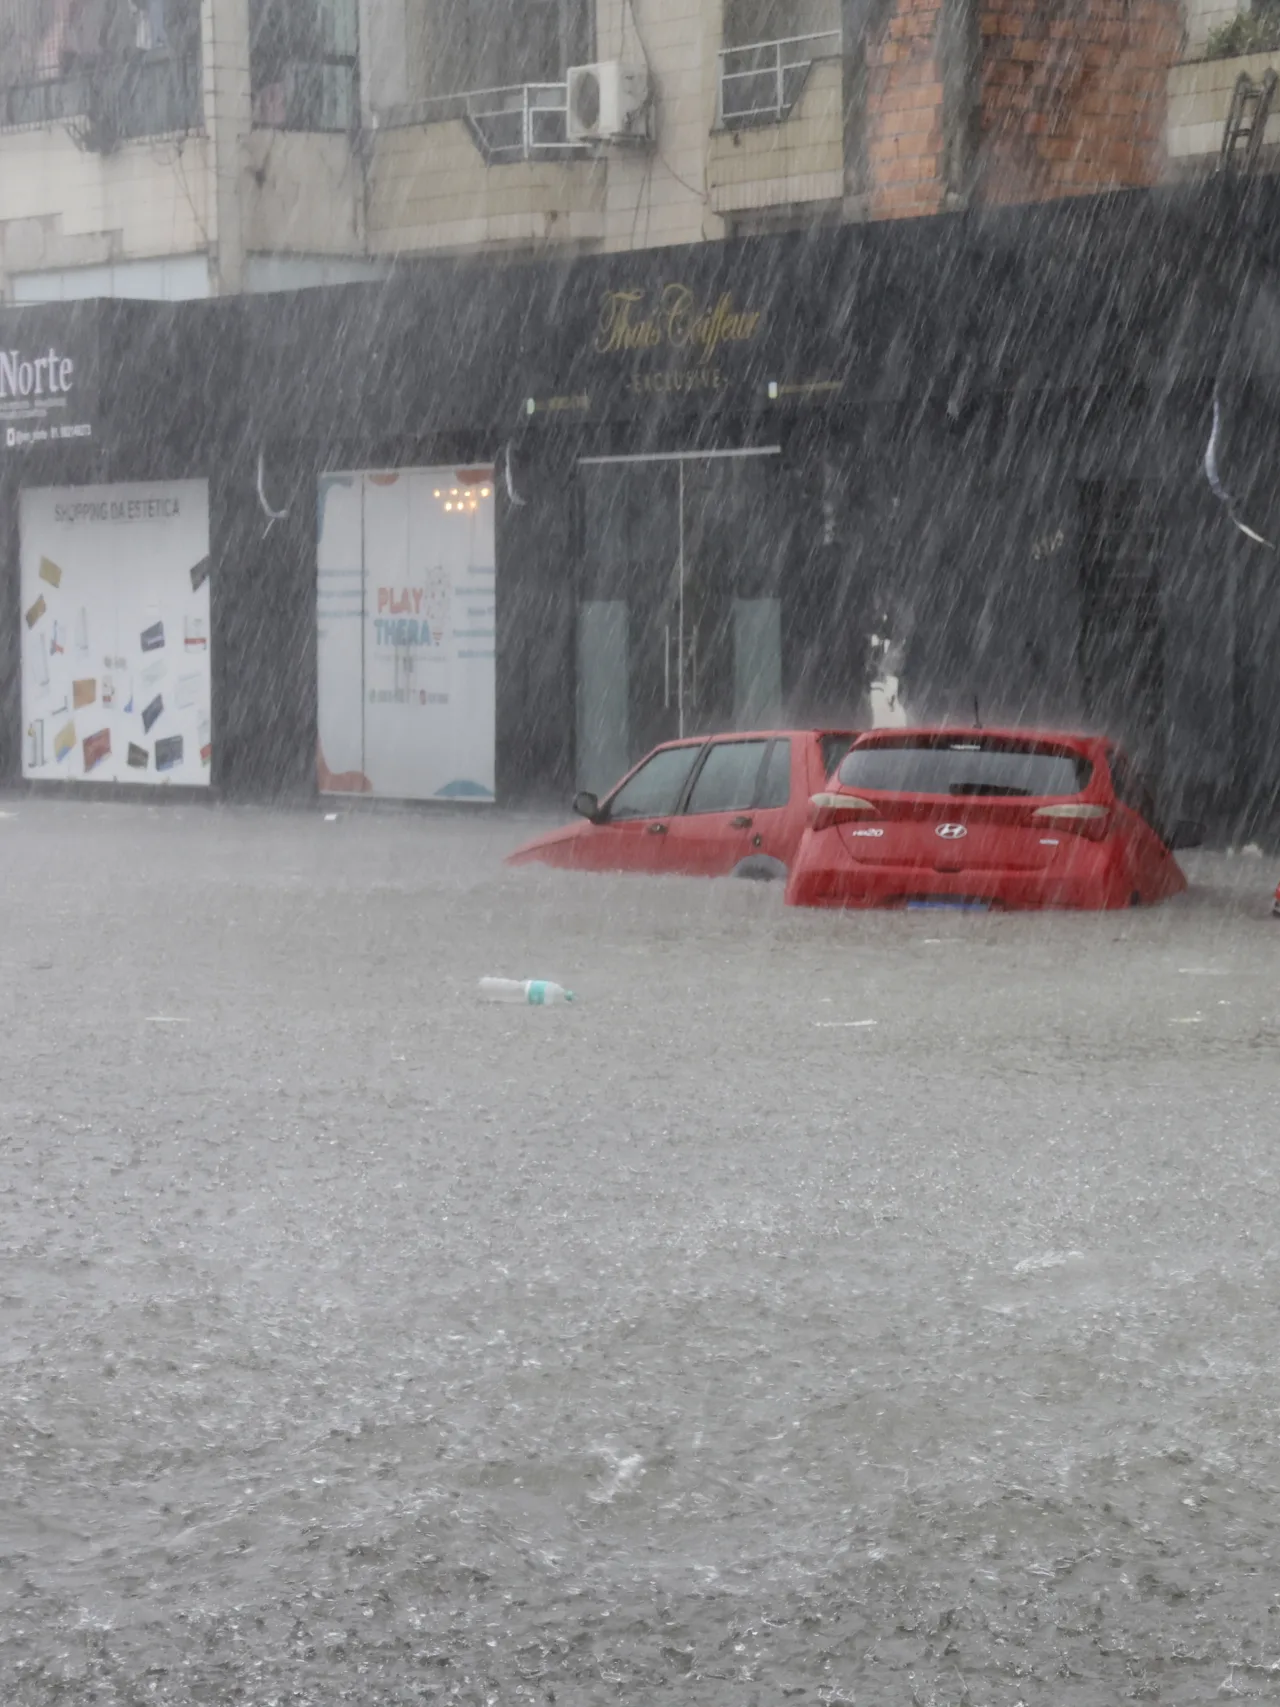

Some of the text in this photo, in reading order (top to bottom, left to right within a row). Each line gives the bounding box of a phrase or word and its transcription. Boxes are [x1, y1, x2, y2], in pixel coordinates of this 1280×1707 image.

[0, 347, 74, 397] Norte
[377, 586, 424, 615] PLAY
[374, 618, 432, 647] THERA
